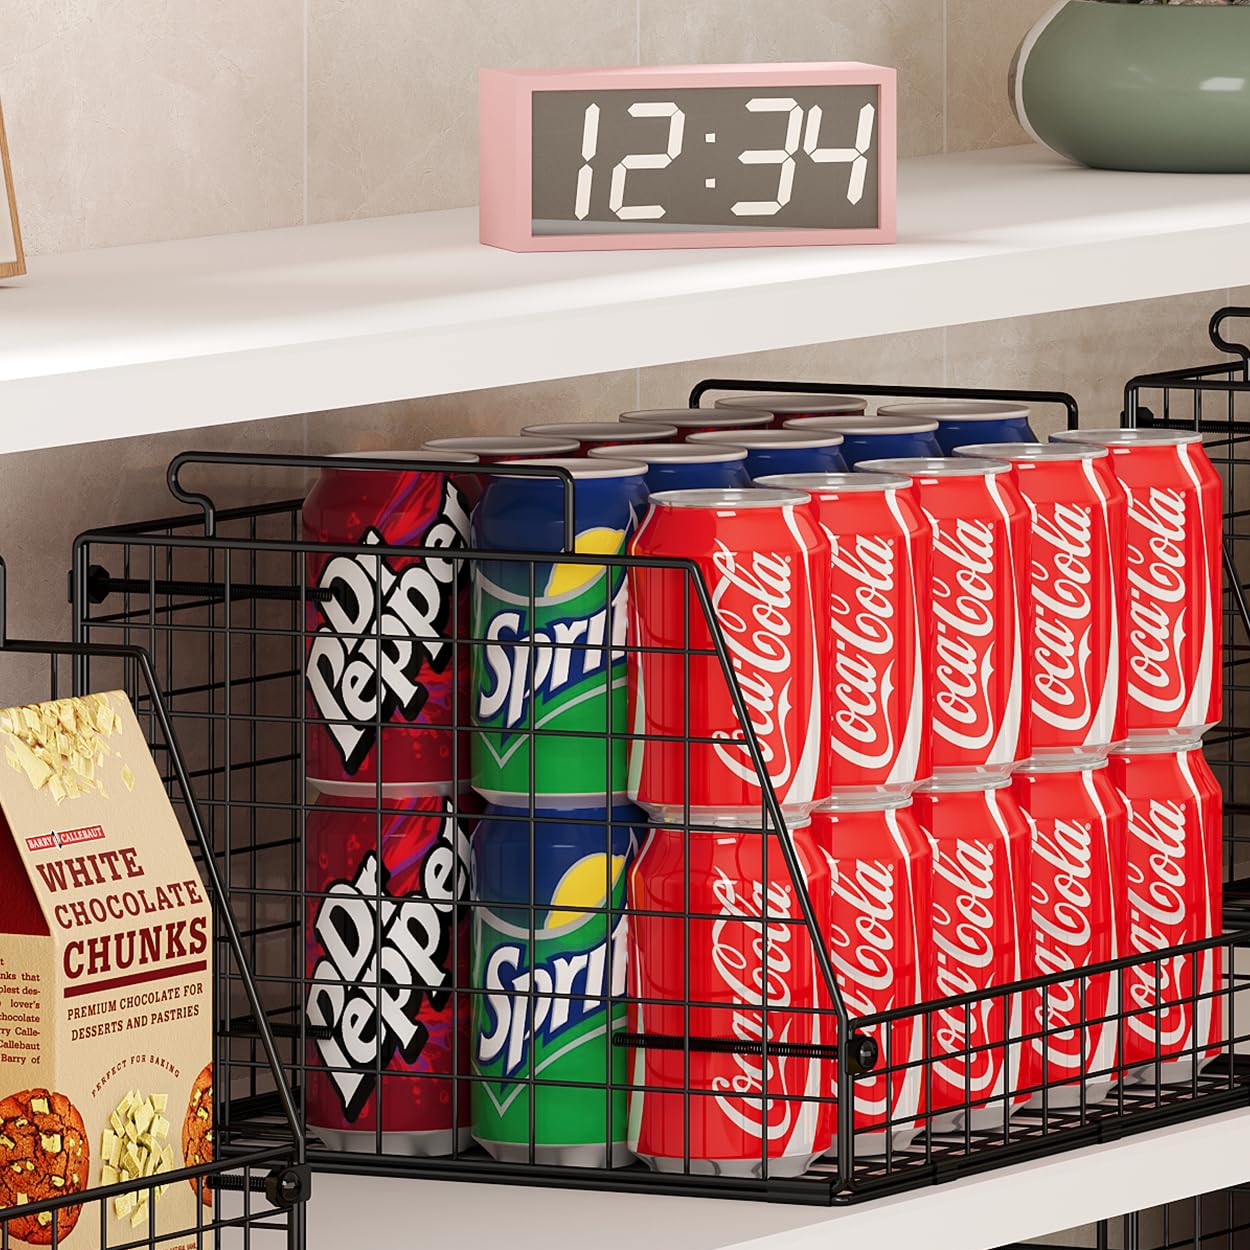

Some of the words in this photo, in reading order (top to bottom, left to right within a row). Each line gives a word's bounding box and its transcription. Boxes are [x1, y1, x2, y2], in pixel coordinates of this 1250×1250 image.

[574, 97, 876, 221] 12:34
[27, 835, 52, 850] BARRY
[61, 827, 103, 845] CALLEBAUT
[36, 847, 144, 893] WHITE
[54, 879, 204, 930] CHOCOLATE
[63, 916, 208, 980] CHUNKS
[21, 972, 40, 982] that
[10, 999, 40, 1009] lover's
[67, 1000, 117, 1021] PREMIUM
[120, 988, 181, 1010] CHOCOLATE
[183, 982, 204, 997] FOR
[71, 1020, 124, 1042] DESSERTS
[126, 1015, 148, 1030] AND
[150, 1004, 200, 1026] PASTRIES
[1, 1054, 26, 1065] Barry
[31, 1055, 40, 1065] of
[91, 1058, 128, 1098] PERFECT
[130, 1054, 146, 1065] FOR
[149, 1054, 181, 1079] BAKING
